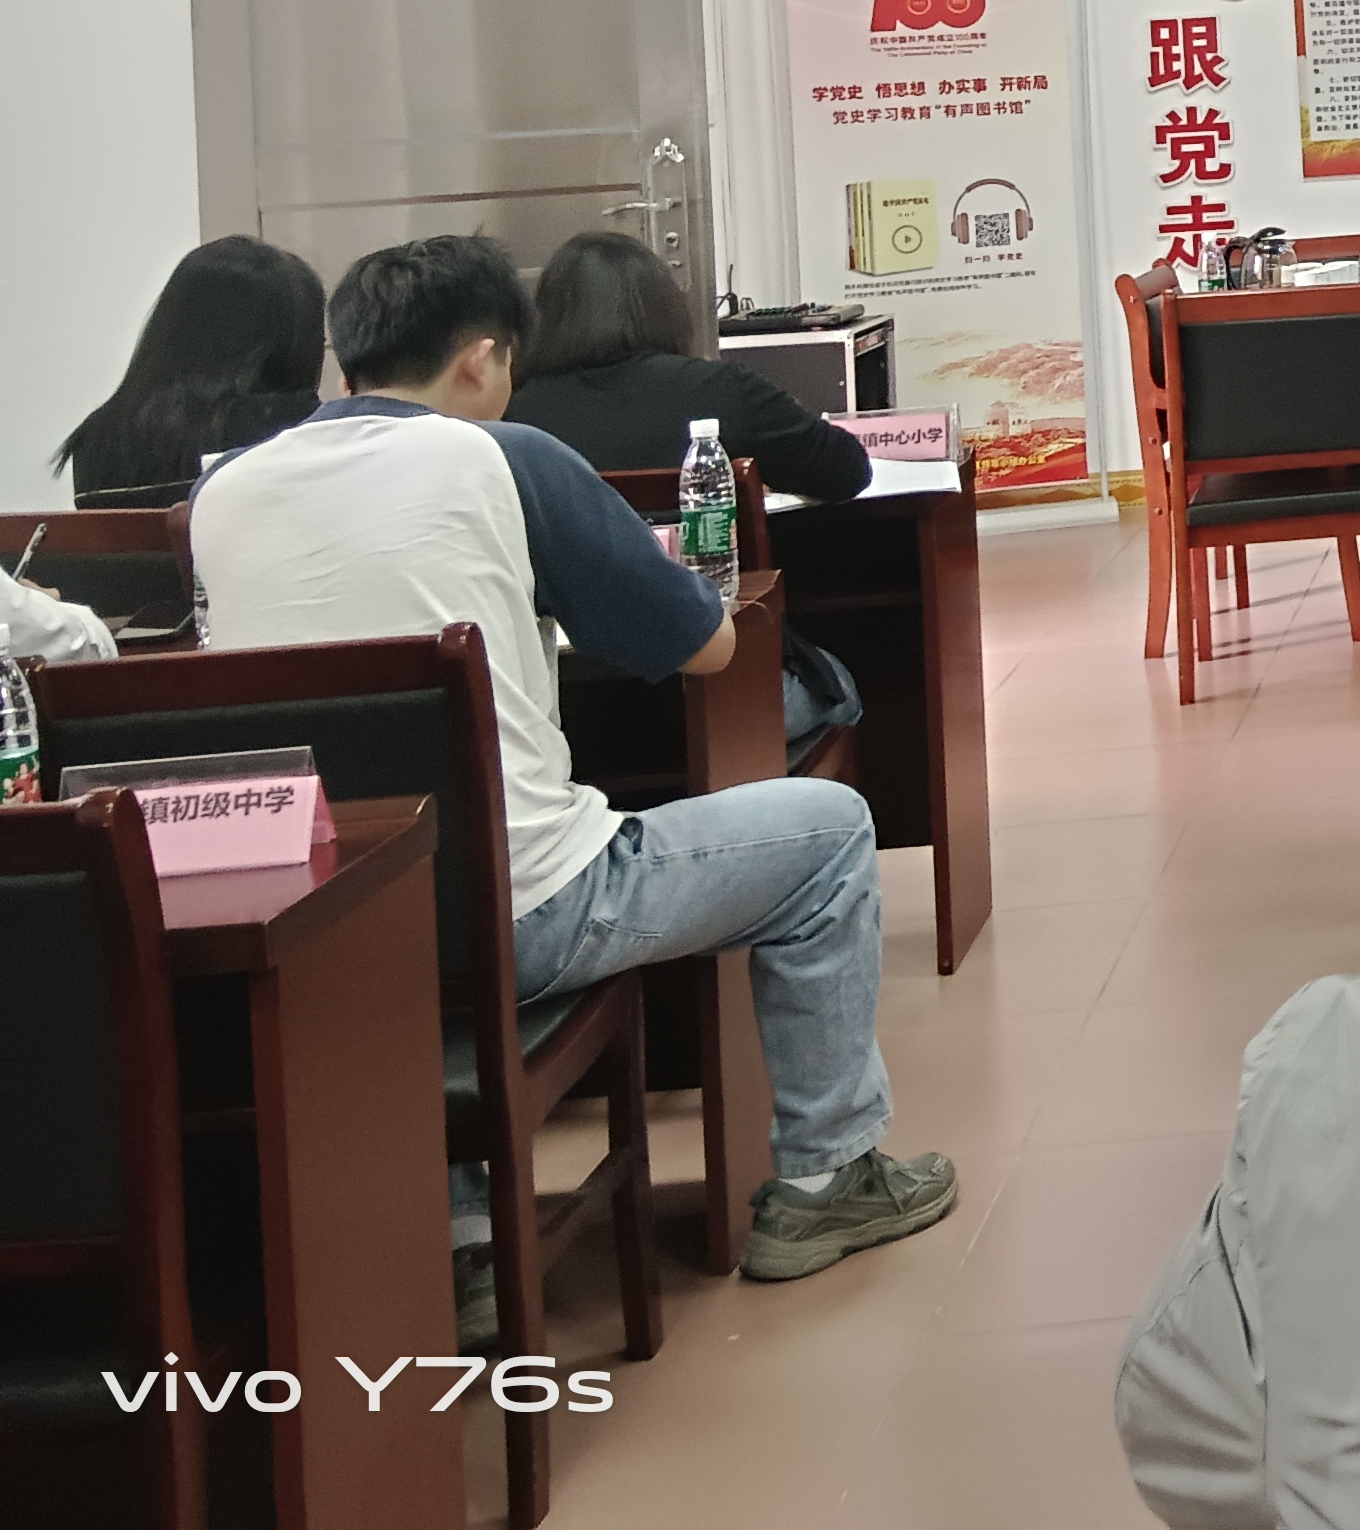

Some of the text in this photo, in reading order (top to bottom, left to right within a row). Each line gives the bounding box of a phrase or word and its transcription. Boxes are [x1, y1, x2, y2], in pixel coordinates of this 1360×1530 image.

[812, 74, 1048, 102] 学党史 悟思想 办实事 开新局
[856, 427, 943, 448] 镇中心小学
[141, 784, 296, 826] 镇初级中学
